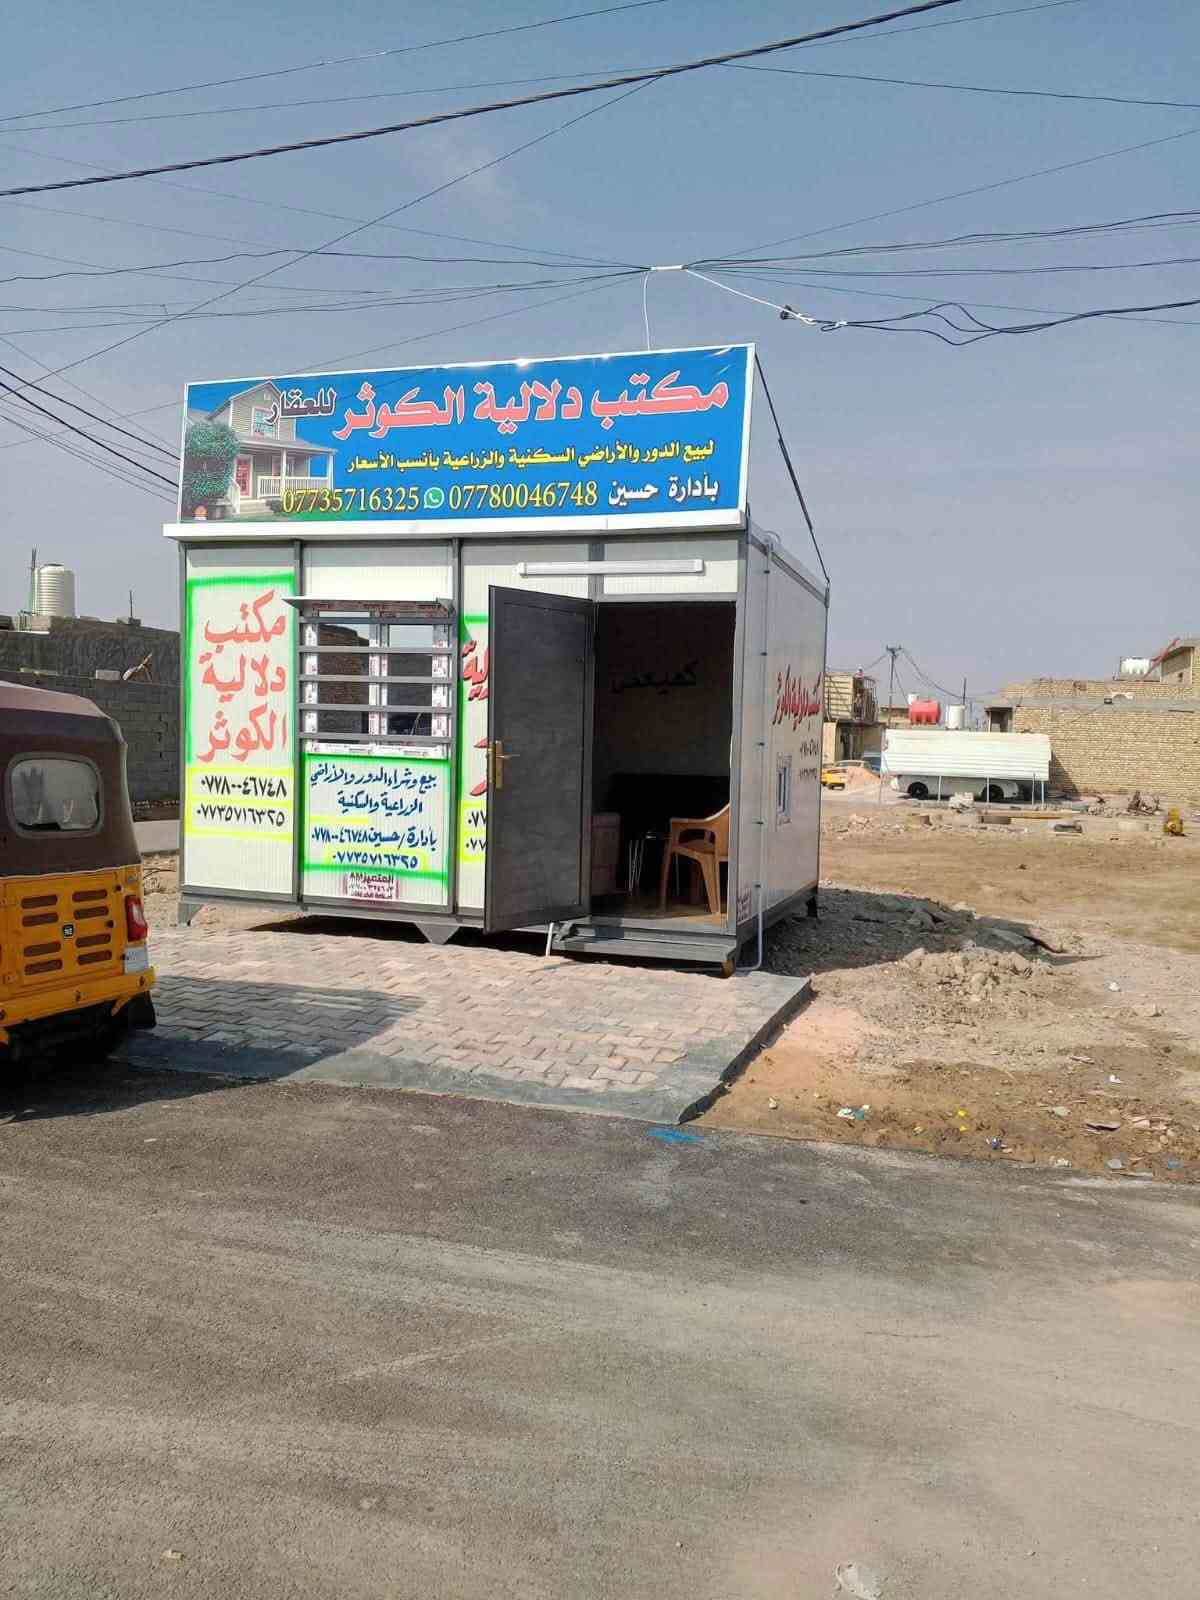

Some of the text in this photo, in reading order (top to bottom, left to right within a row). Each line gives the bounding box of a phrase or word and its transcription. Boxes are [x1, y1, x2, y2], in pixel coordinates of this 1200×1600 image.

[264, 370, 729, 440] مكتب دلالية الكوثر للعقار
[347, 440, 714, 473] لبيع الدور والأراضي السكنية والزراعية بأنسب الأسعار
[282, 486, 420, 513] 07735716325
[449, 480, 598, 510] 07780046748
[608, 481, 659, 506] حسين
[204, 589, 286, 653] مكتب
[198, 653, 286, 702] دلالية
[197, 702, 287, 763] الكوثر
[355, 766, 387, 785] الدور
[388, 768, 418, 789] وشراء
[419, 774, 438, 794] بيع
[337, 790, 423, 816] الزراعية والسكنية
